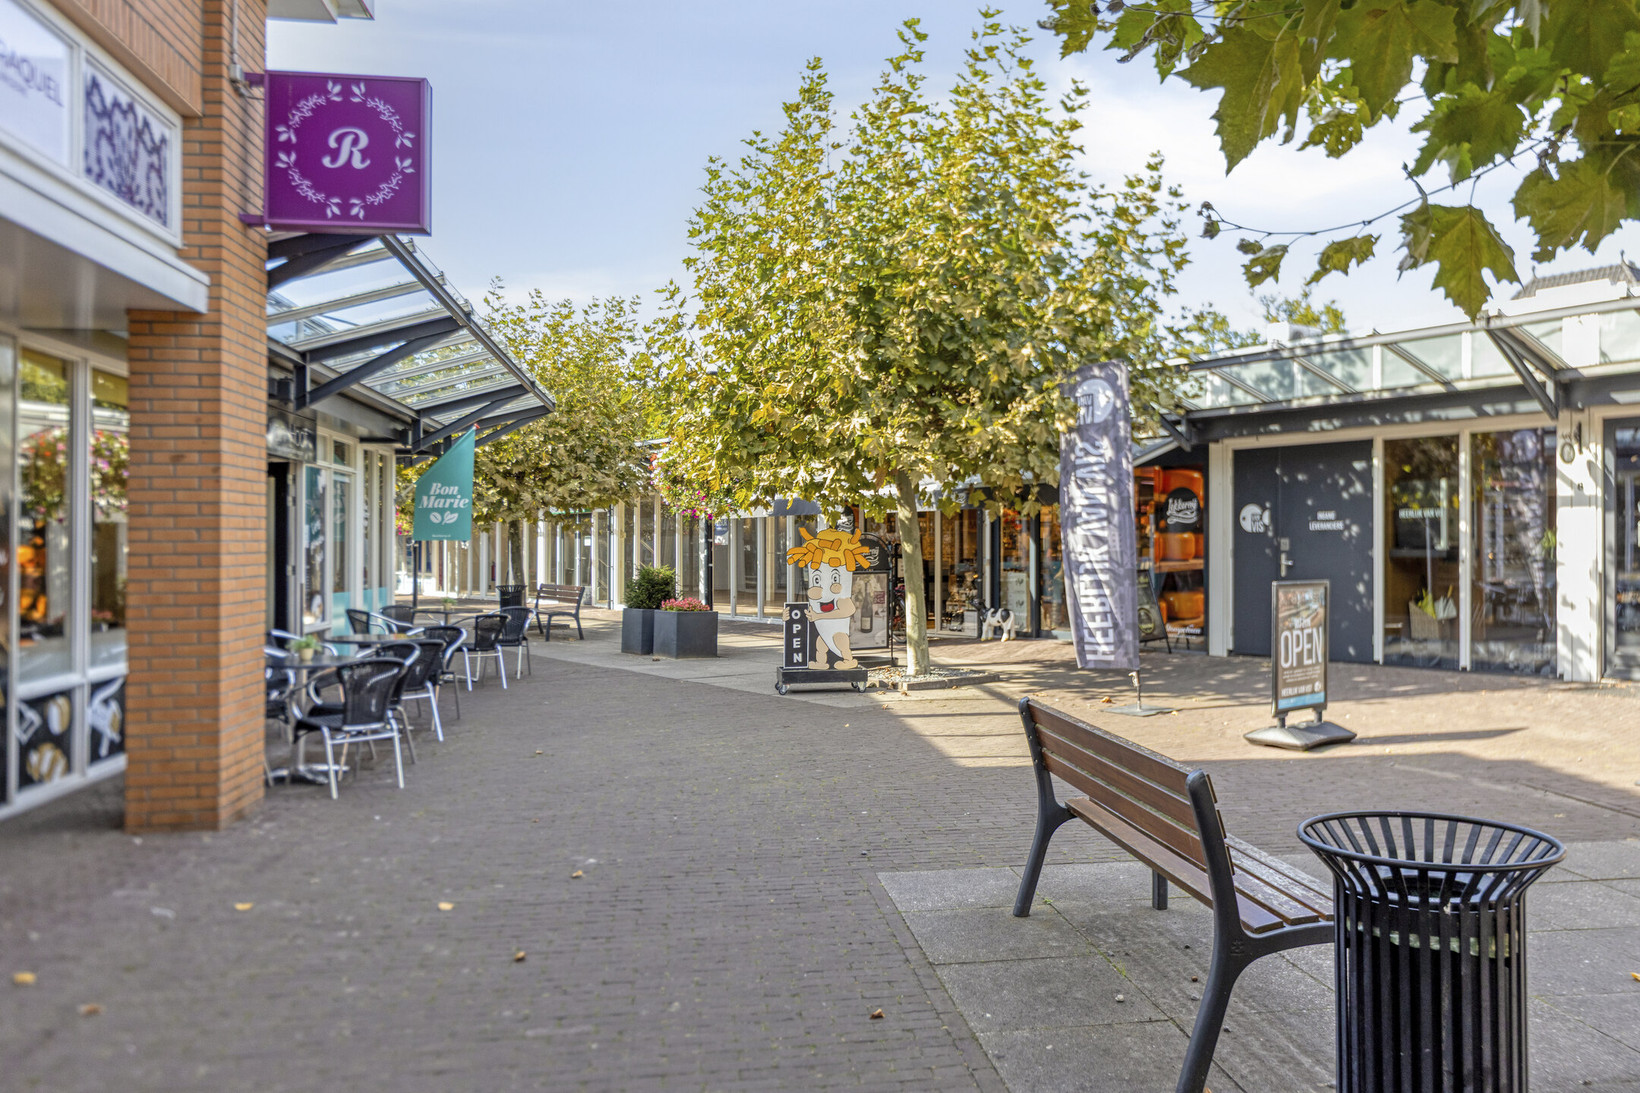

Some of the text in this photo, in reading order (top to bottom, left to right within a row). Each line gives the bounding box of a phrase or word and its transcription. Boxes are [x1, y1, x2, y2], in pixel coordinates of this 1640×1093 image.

[321, 126, 371, 170] R
[418, 495, 469, 509] Marie
[429, 482, 459, 496] Bon
[1251, 521, 1265, 533] VIS
[791, 609, 803, 663] OPEN
[1281, 627, 1322, 668] OPEN
